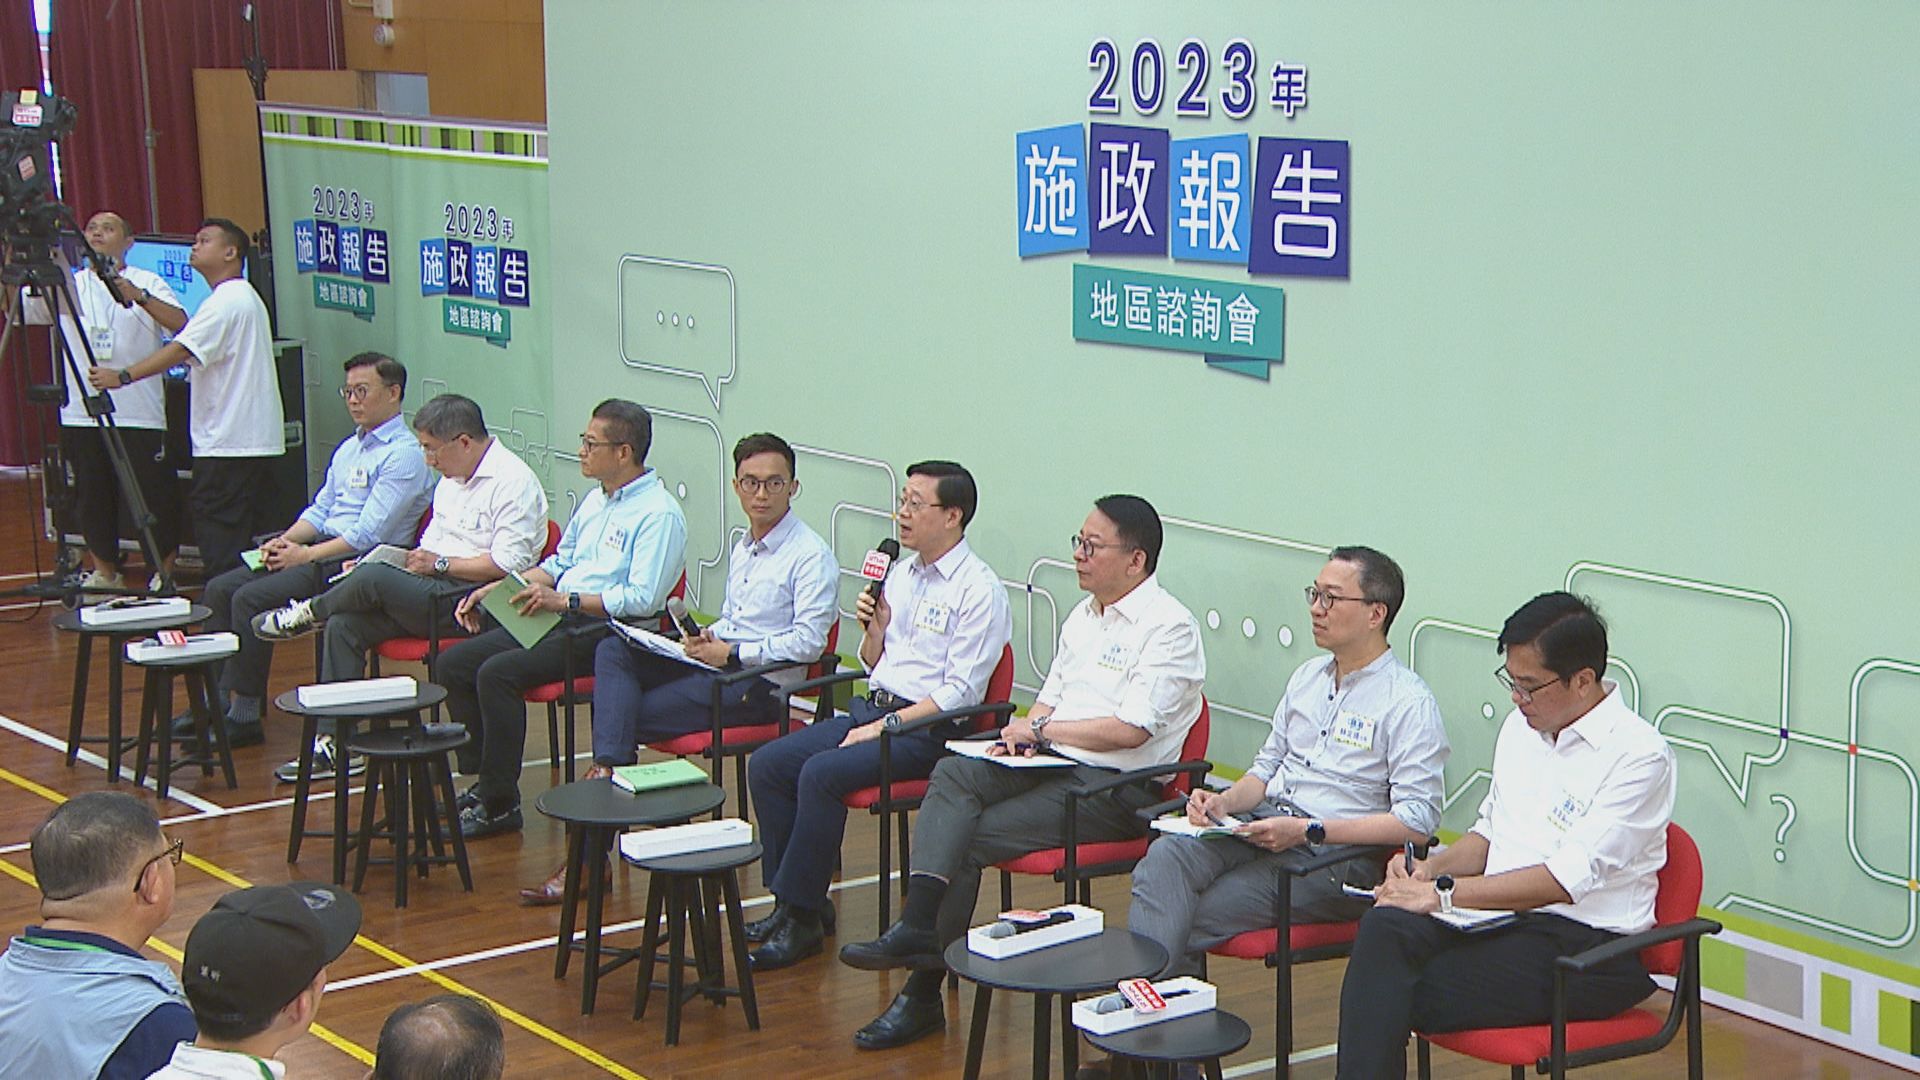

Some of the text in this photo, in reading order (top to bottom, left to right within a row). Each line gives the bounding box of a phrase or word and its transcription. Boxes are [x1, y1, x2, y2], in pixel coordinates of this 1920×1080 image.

[1086, 37, 1308, 118] 2023年
[312, 185, 374, 222] 2023年
[444, 202, 514, 242] 2023年
[1024, 141, 1342, 259] 施政報告
[296, 224, 387, 276] 施政報告
[422, 243, 527, 299] 施政報告
[319, 282, 368, 308] 地區諮詢會
[449, 307, 503, 334] 地區諮詢會
[1090, 280, 1260, 345] 地區諮詢會
